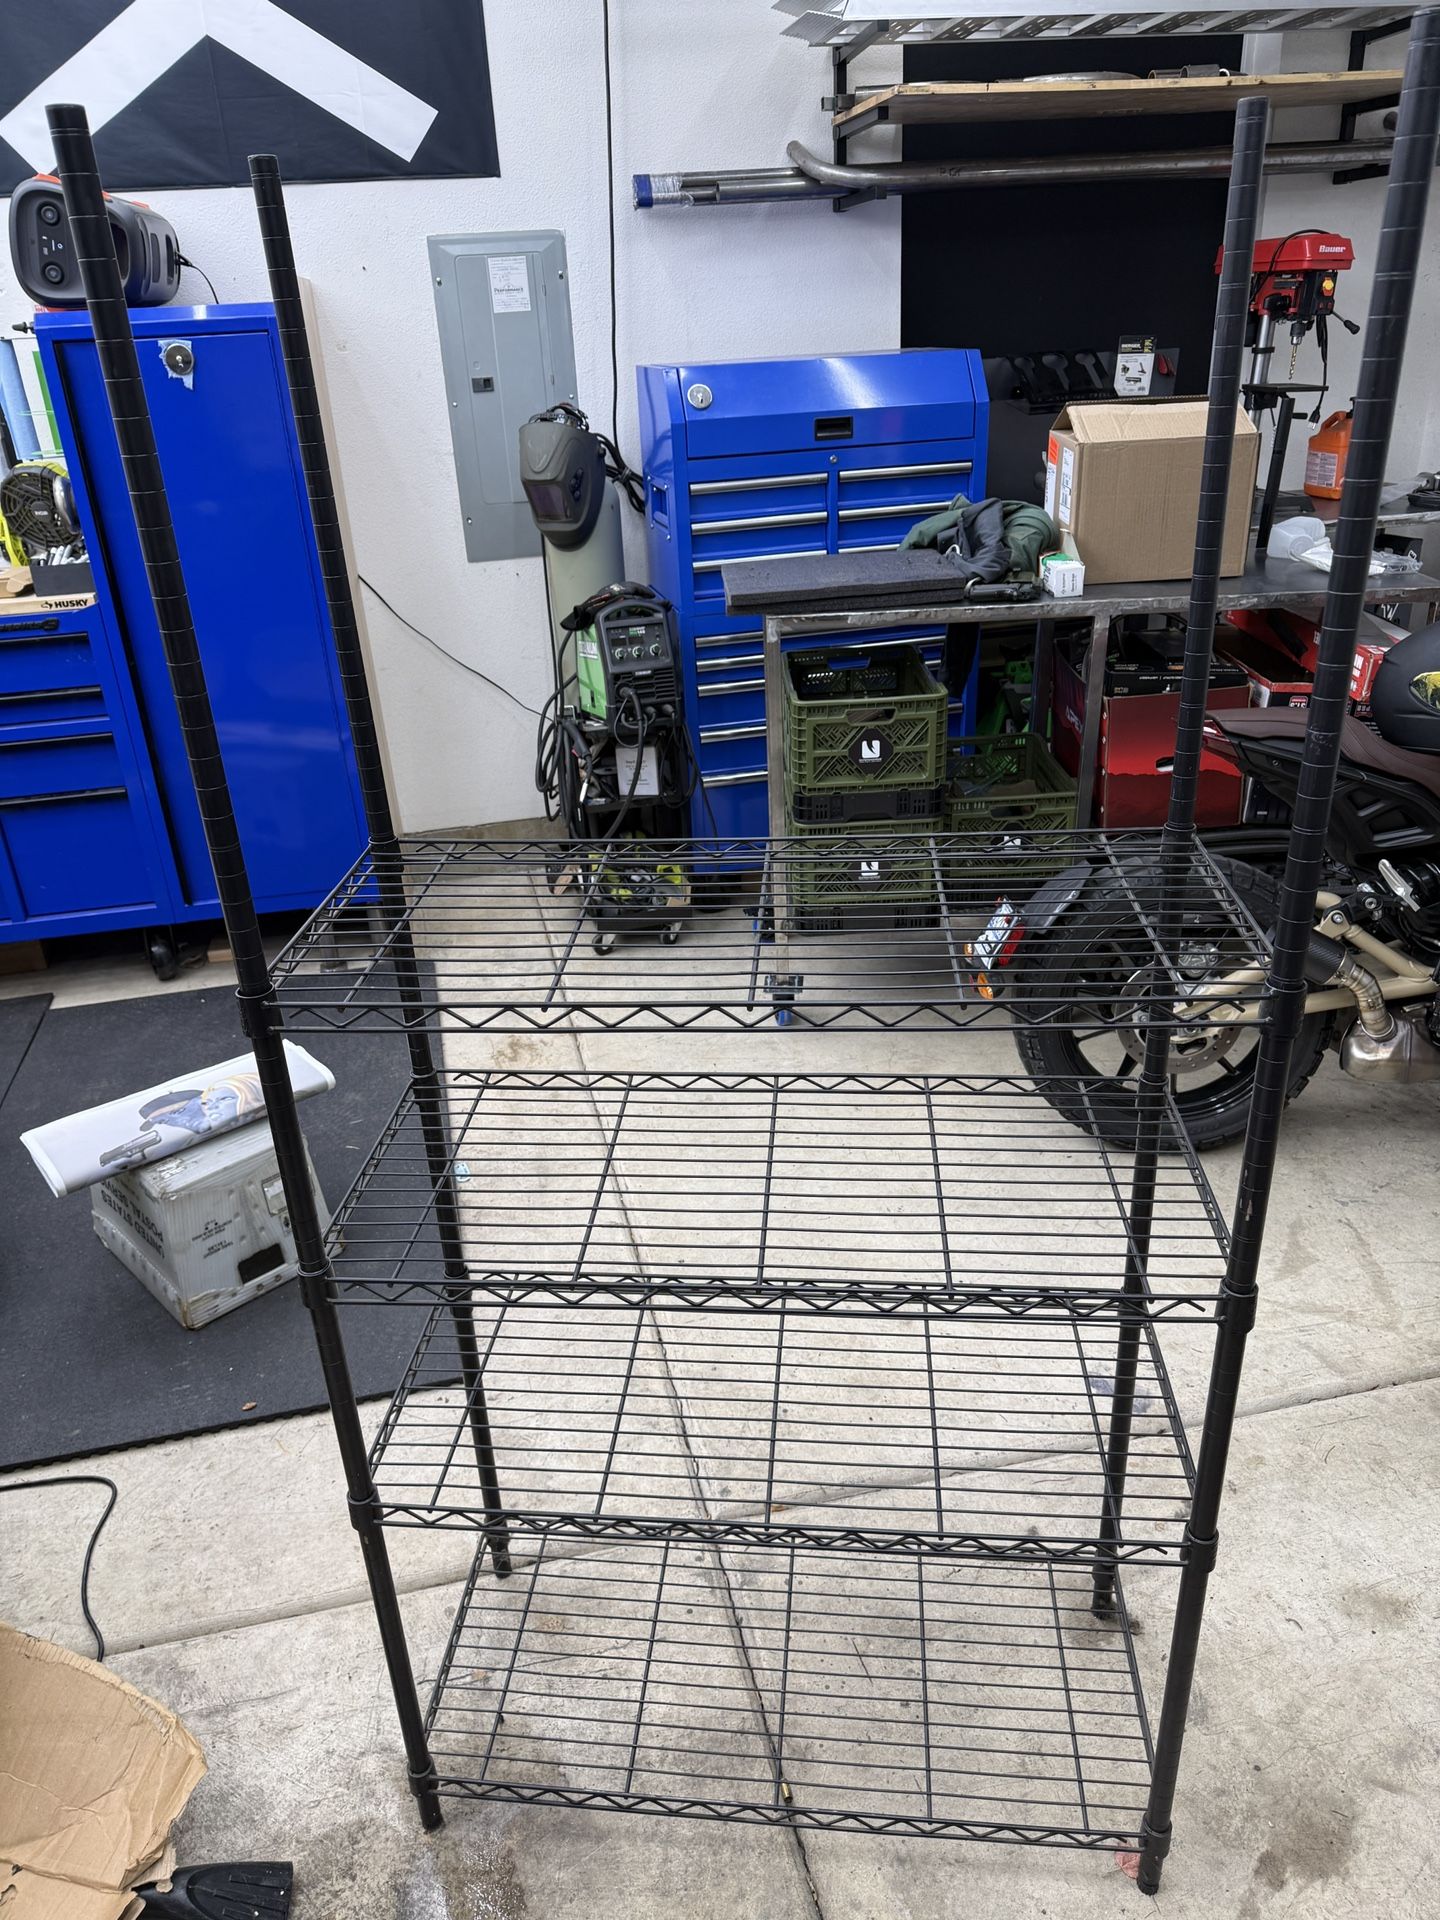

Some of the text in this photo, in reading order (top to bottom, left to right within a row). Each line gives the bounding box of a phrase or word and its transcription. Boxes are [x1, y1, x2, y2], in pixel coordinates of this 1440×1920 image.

[1319, 244, 1346, 253] Bauer
[54, 599, 88, 609] HUSKY
[101, 1190, 133, 1227] STATES
[129, 1200, 164, 1243] POSTAL
[134, 1221, 165, 1260] UNITED
